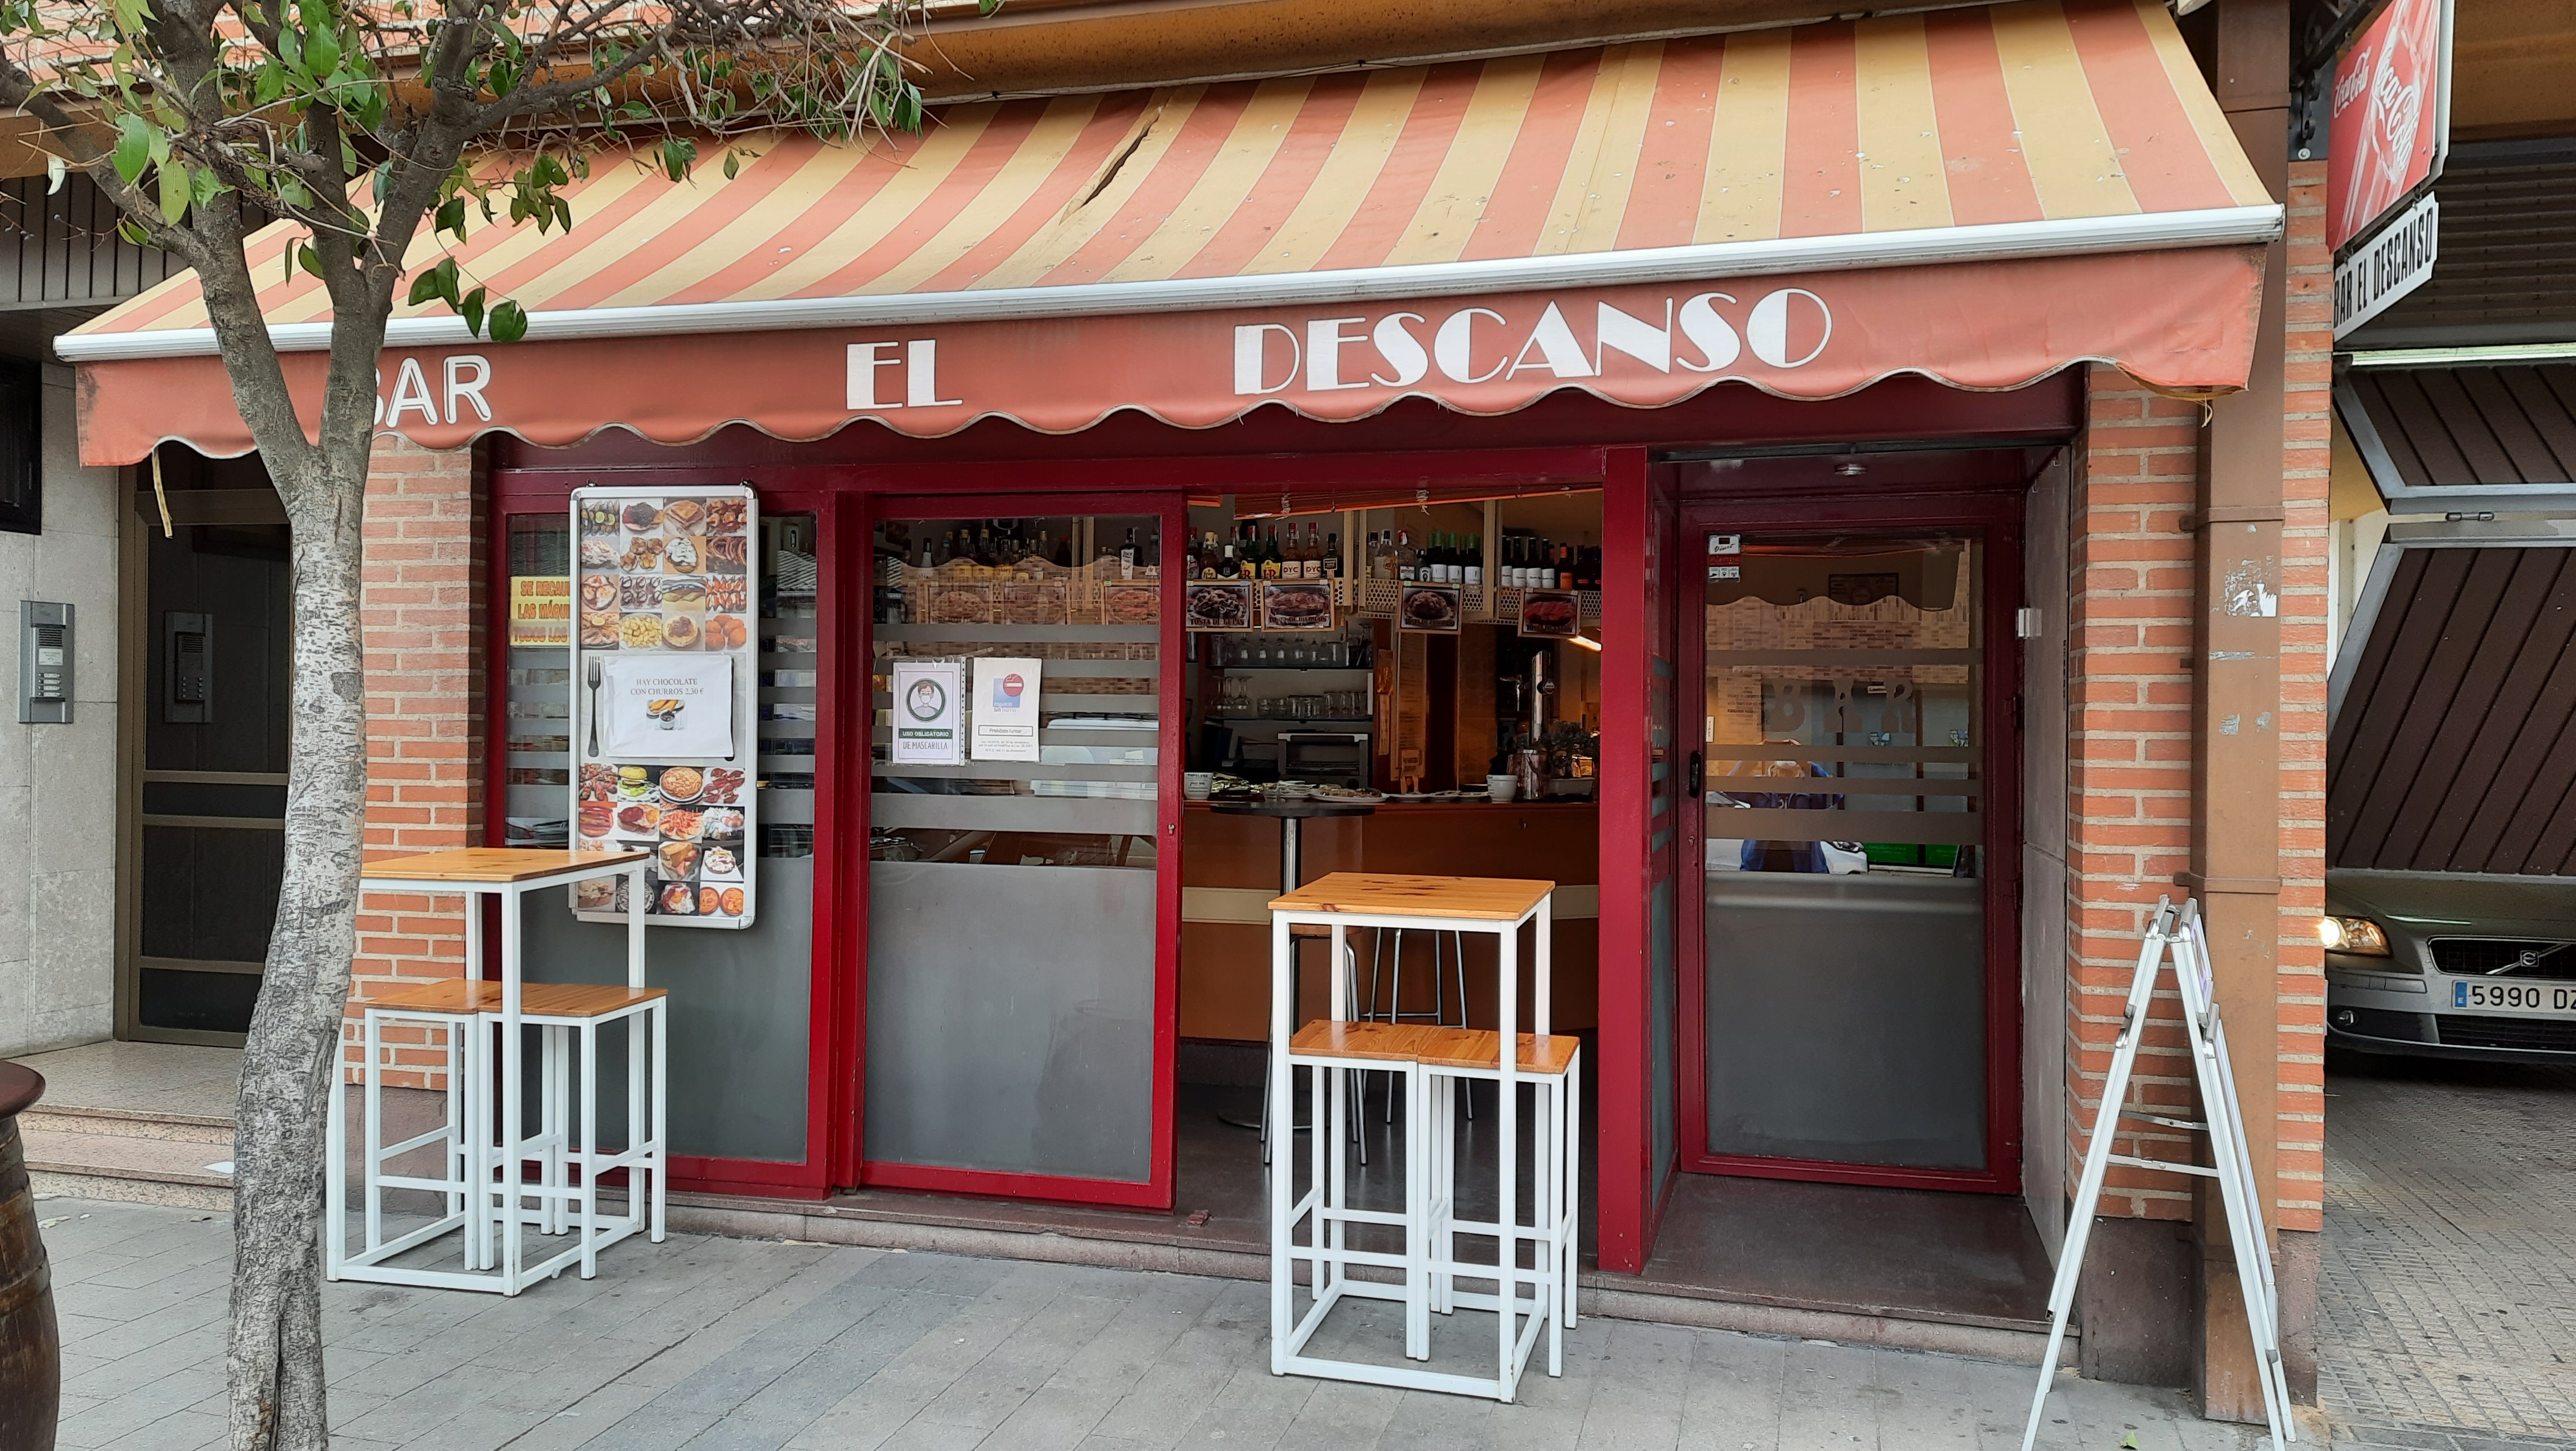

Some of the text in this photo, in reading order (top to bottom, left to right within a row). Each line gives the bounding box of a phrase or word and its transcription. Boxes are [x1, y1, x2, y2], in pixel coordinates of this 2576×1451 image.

[2334, 206, 2433, 329] BAR EL DESCANSO
[847, 339, 963, 410] EL
[1234, 287, 1832, 396] DESCANSO
[520, 581, 534, 596] SE
[518, 603, 536, 619] LAS
[548, 627, 567, 642] LOS
[1765, 678, 1915, 732] BAR
[2472, 985, 2540, 1008] 5990
